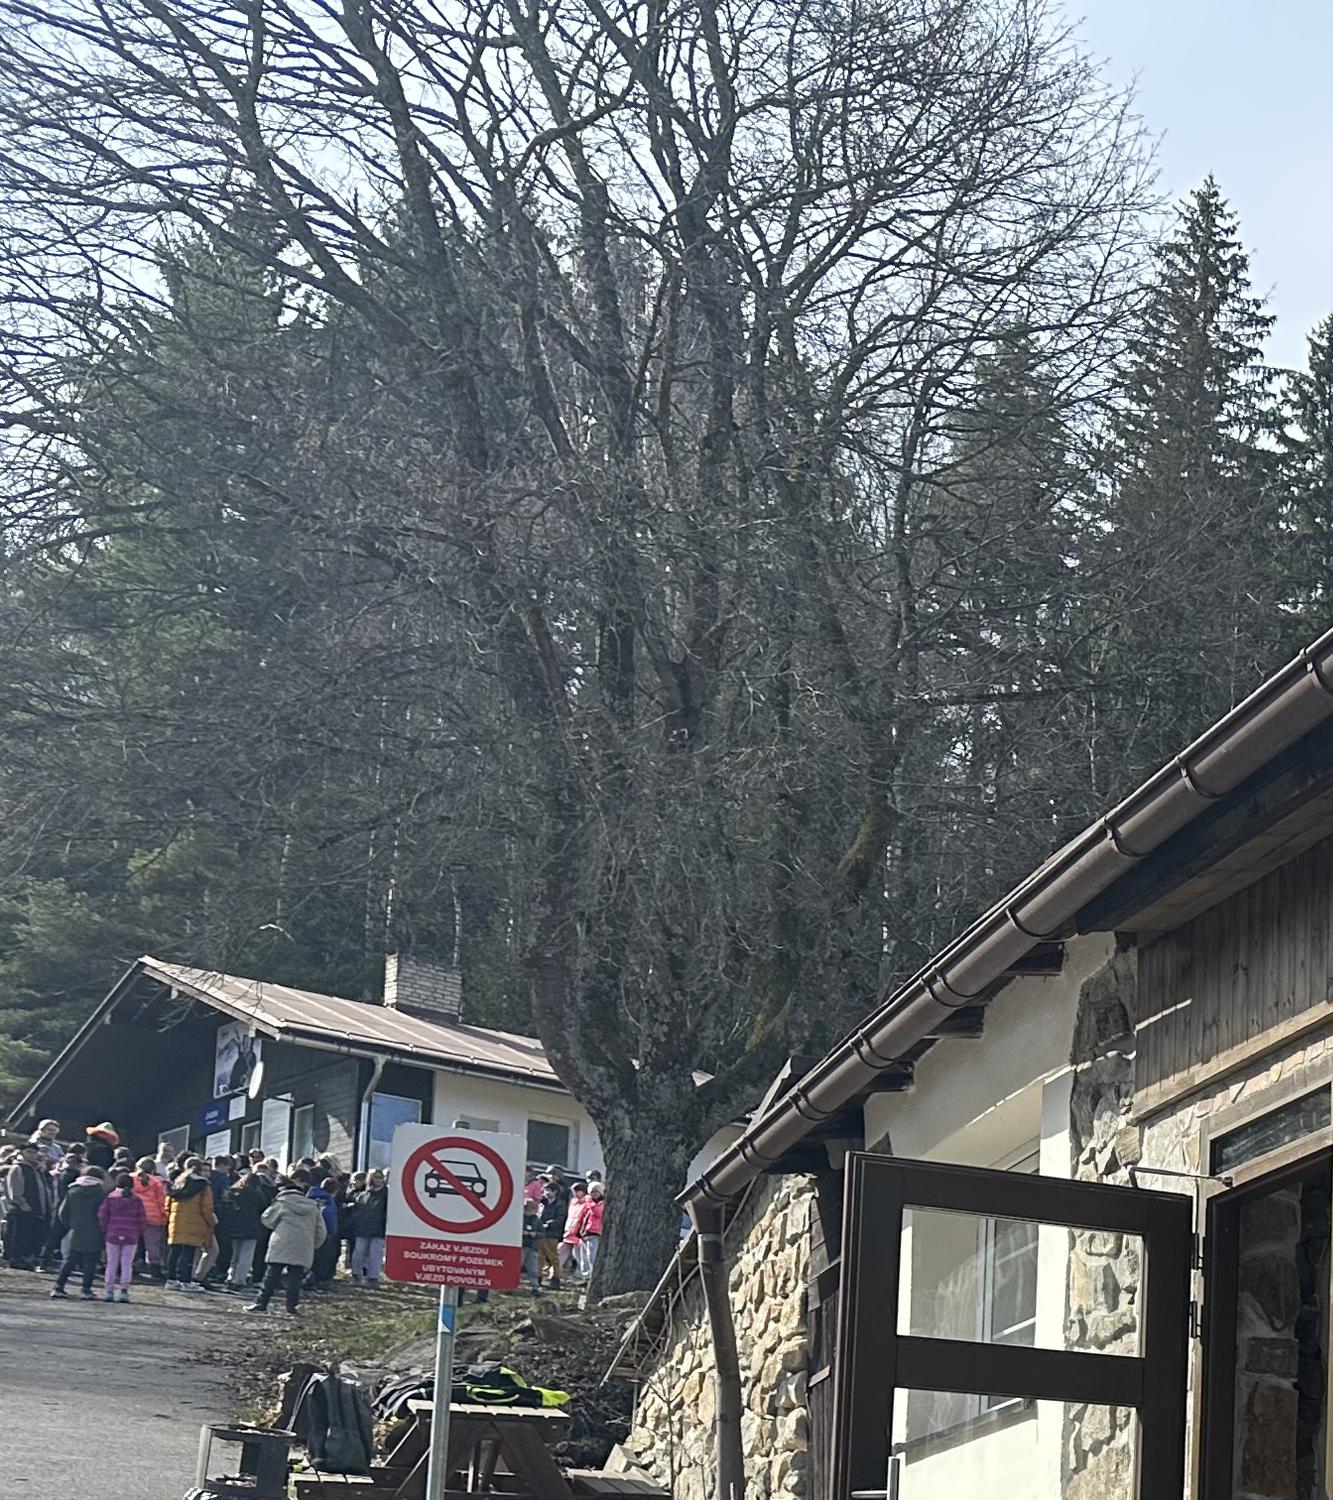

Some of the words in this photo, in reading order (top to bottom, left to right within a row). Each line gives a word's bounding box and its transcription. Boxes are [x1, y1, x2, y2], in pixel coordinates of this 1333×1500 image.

[453, 1244, 489, 1255] VJEZDU
[459, 1255, 504, 1267] POZEMEK
[415, 1272, 445, 1282] VJEZD
[446, 1275, 491, 1286] POVOLEN
